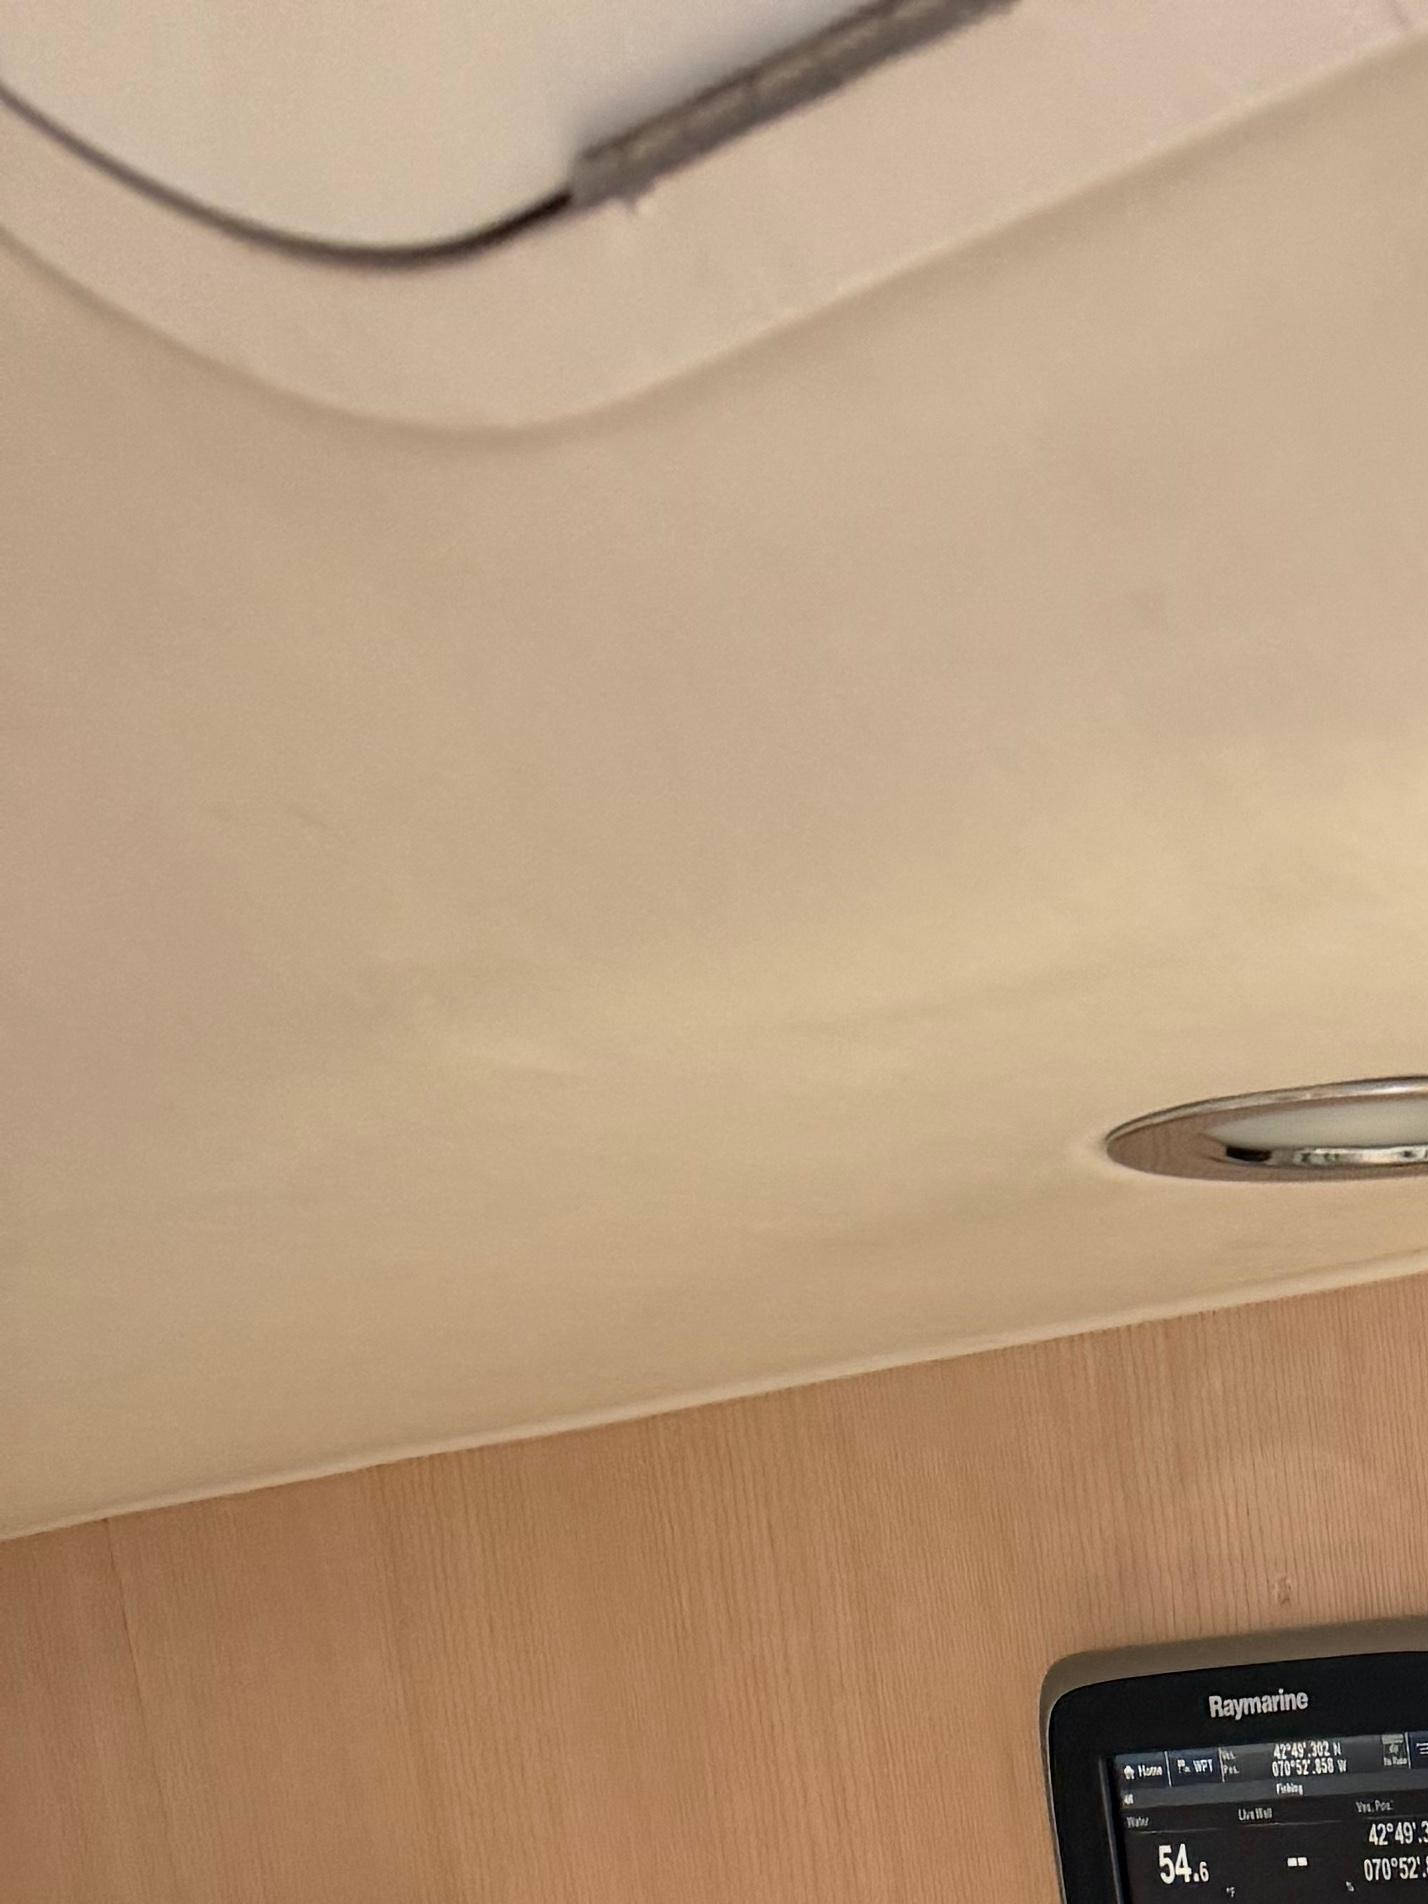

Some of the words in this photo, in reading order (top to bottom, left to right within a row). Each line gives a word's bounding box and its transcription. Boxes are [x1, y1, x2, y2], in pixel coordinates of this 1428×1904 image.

[1208, 1688, 1308, 1720] Raymarine
[1193, 1758, 1215, 1774] WPT
[1158, 1843, 1210, 1884] 54.6
